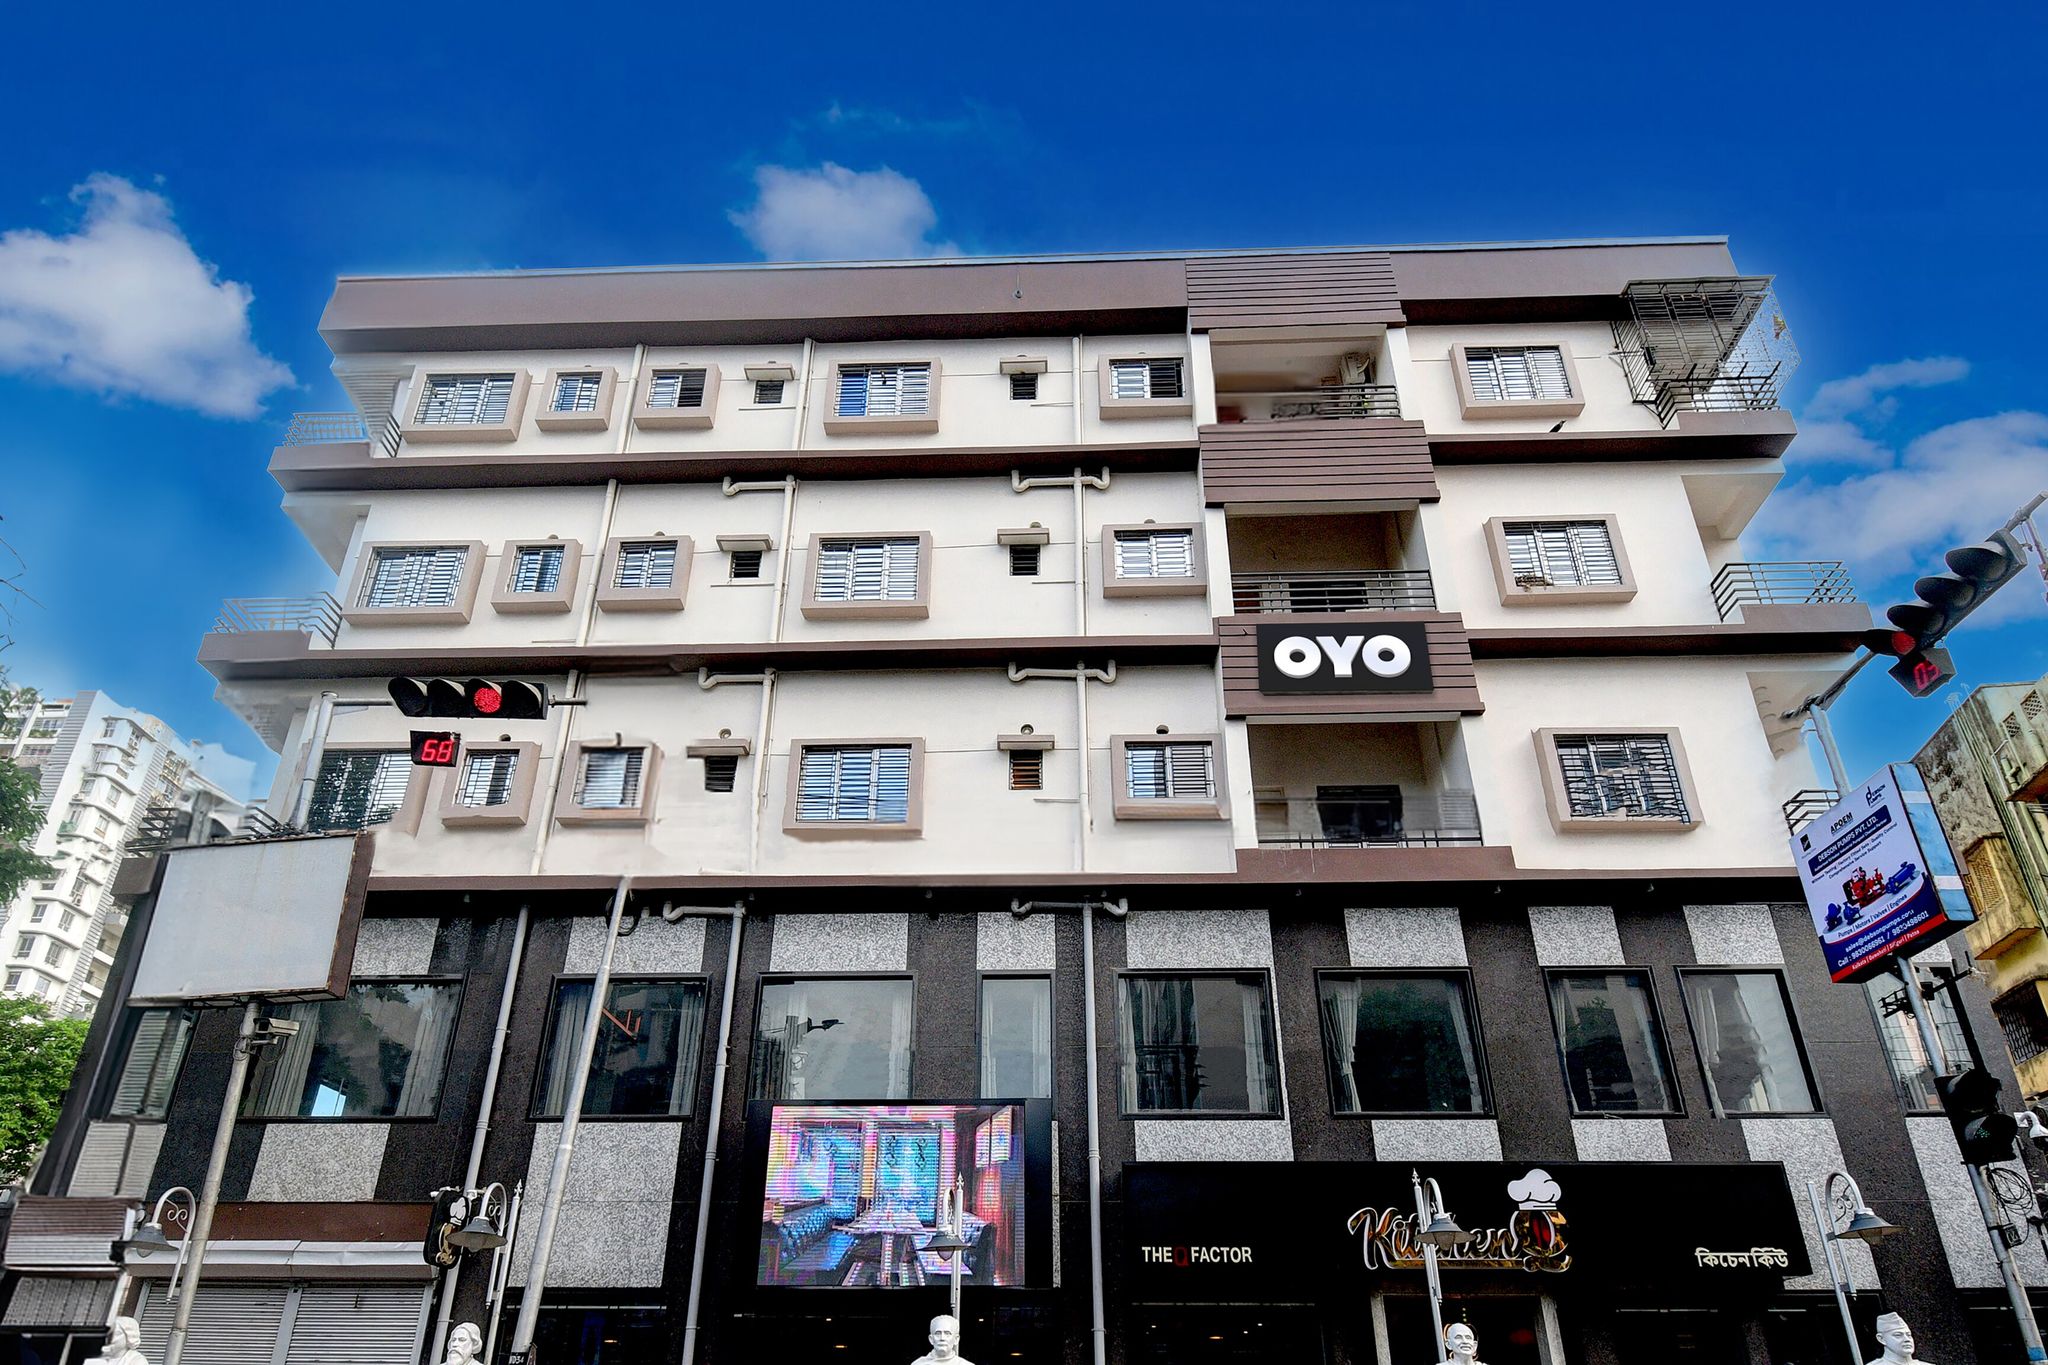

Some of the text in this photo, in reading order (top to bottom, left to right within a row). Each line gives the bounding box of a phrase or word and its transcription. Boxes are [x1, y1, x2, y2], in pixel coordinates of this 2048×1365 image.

[1274, 635, 1411, 678] OYO
[1818, 845, 1837, 862] DEBSON
[1837, 832, 1855, 848] PUMPS
[1855, 824, 1867, 835] PVT.
[1866, 815, 1878, 827] LTD.
[1829, 813, 1853, 833] APOEM
[1838, 894, 1908, 938] Pumps Motors Valves Engines
[1142, 1246, 1253, 1266] THE Q FACTOR
[1694, 1247, 1750, 1267] কিচেন
